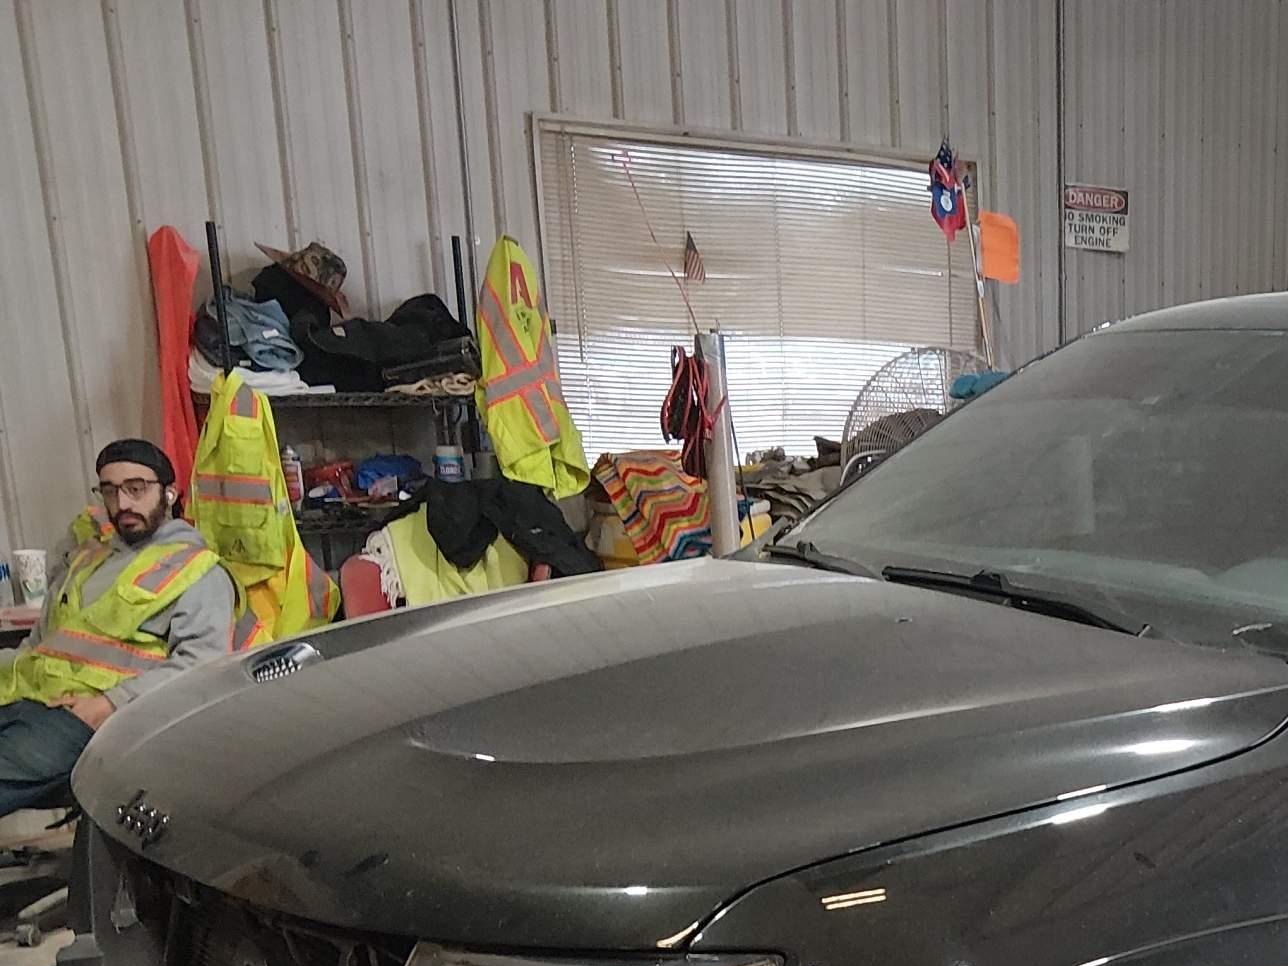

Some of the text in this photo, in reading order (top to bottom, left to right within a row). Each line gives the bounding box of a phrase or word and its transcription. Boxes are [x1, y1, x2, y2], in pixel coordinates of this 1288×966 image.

[1068, 191, 1119, 208] DANGER
[1078, 213, 1126, 226] SMOKING
[1068, 223, 1119, 237] TURN OFF
[1074, 235, 1112, 248] ENGINE
